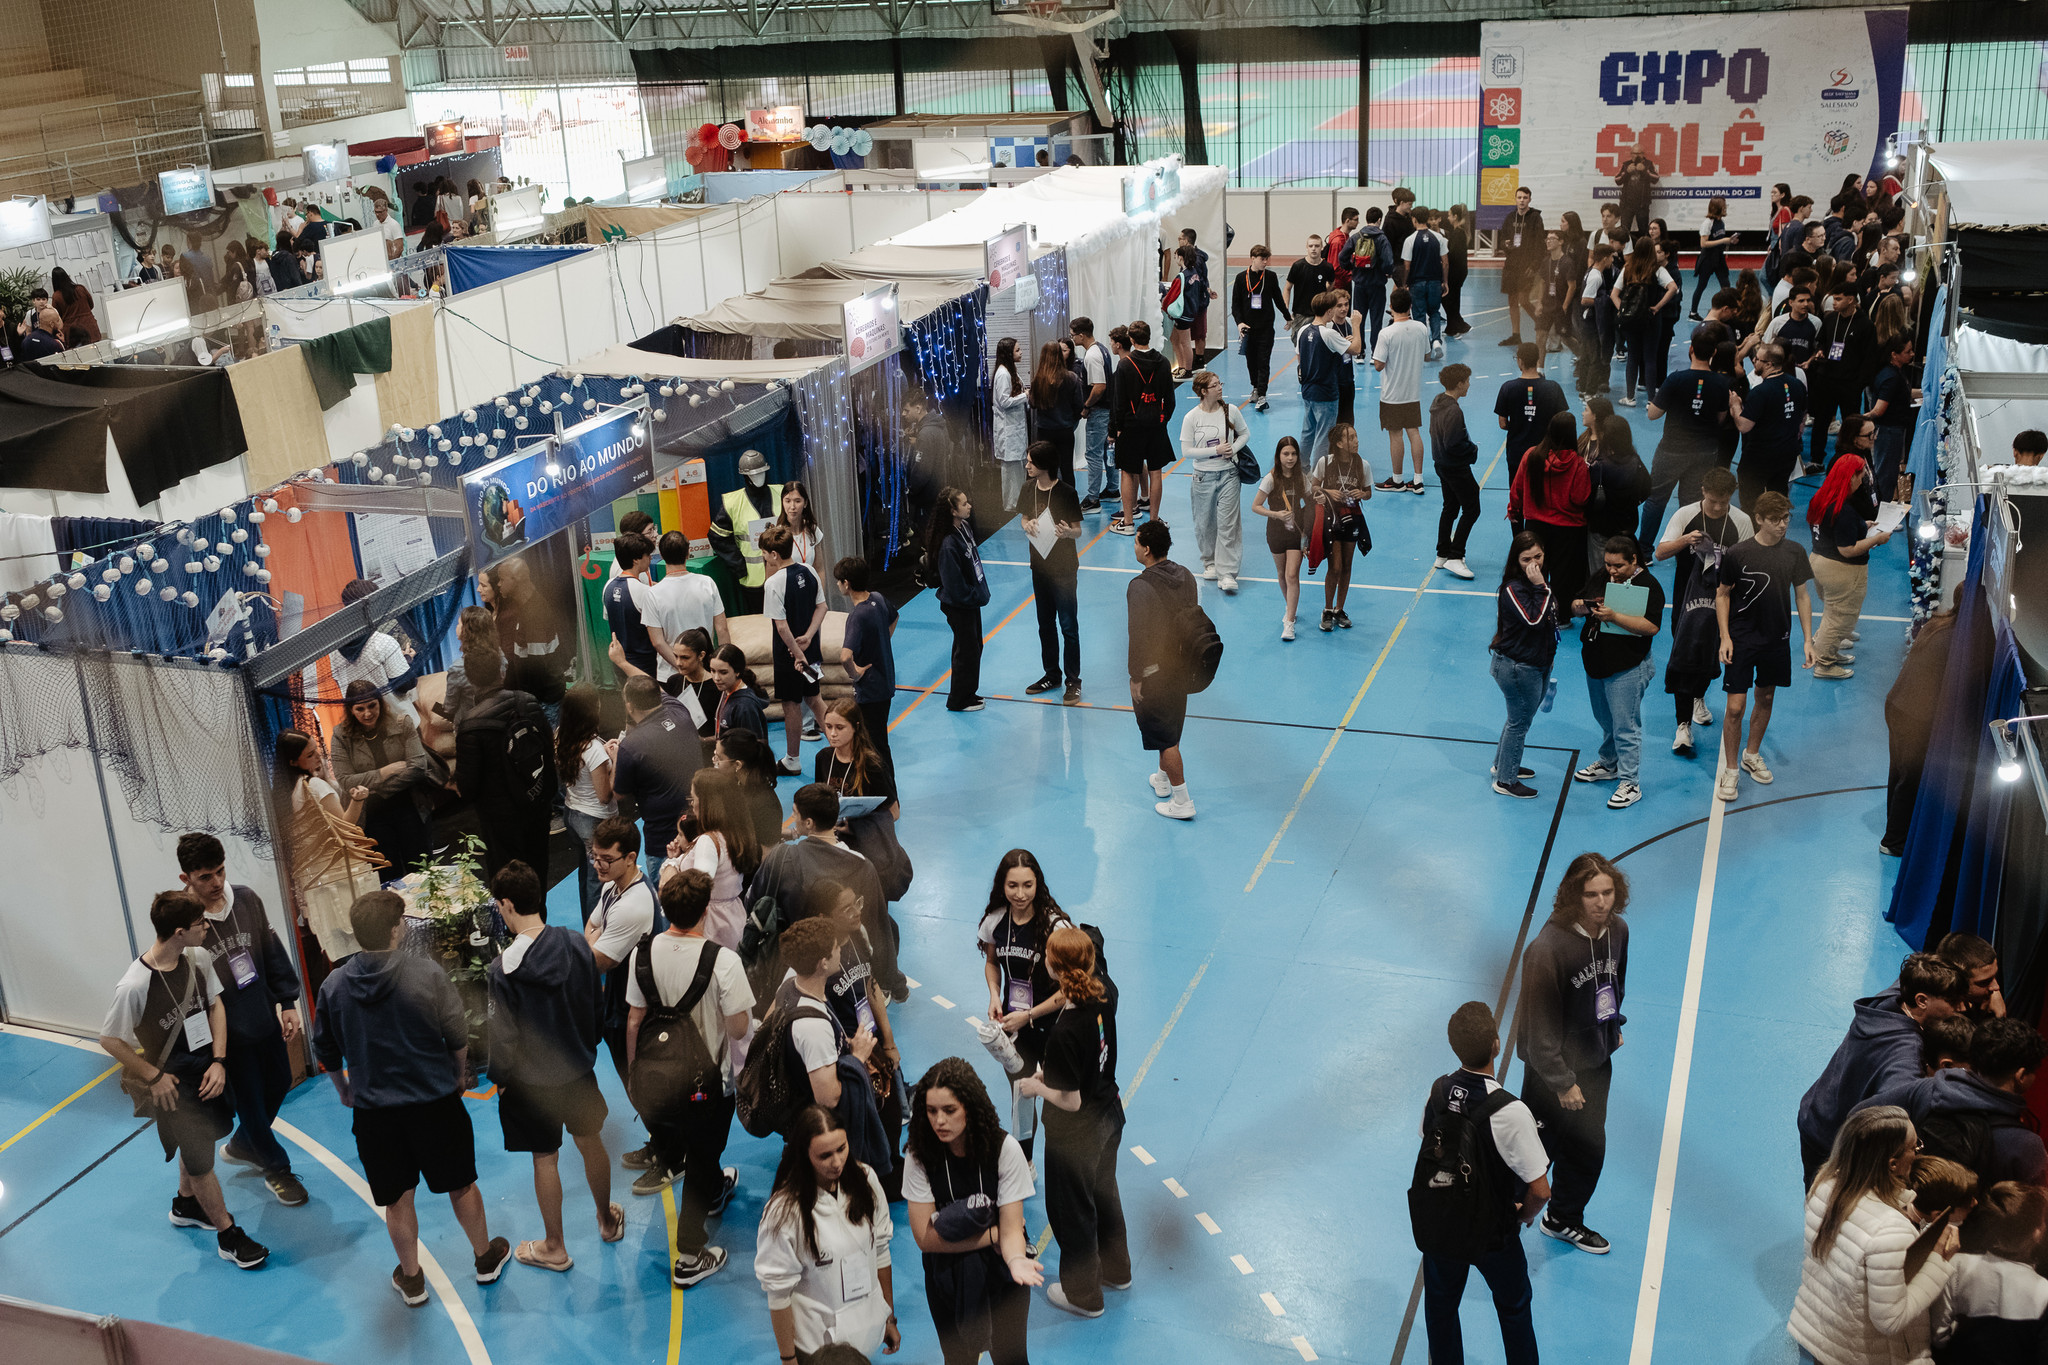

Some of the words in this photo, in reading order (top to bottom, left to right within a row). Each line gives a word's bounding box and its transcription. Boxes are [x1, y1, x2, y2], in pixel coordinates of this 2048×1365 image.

[1599, 47, 1770, 106] EXPO
[1820, 101, 1859, 109] SALESIANO
[526, 476, 548, 500] DO
[552, 464, 577, 488] RIO
[580, 454, 596, 477] AO
[597, 434, 644, 467] MUNDO
[637, 472, 646, 480] ANO
[478, 510, 484, 526] DO
[482, 480, 490, 491] AO
[489, 477, 511, 495] MUNDO
[1685, 597, 1716, 612] SALESIA
[832, 962, 872, 997] SALESIAN
[1570, 958, 1617, 989] SALESIAN
